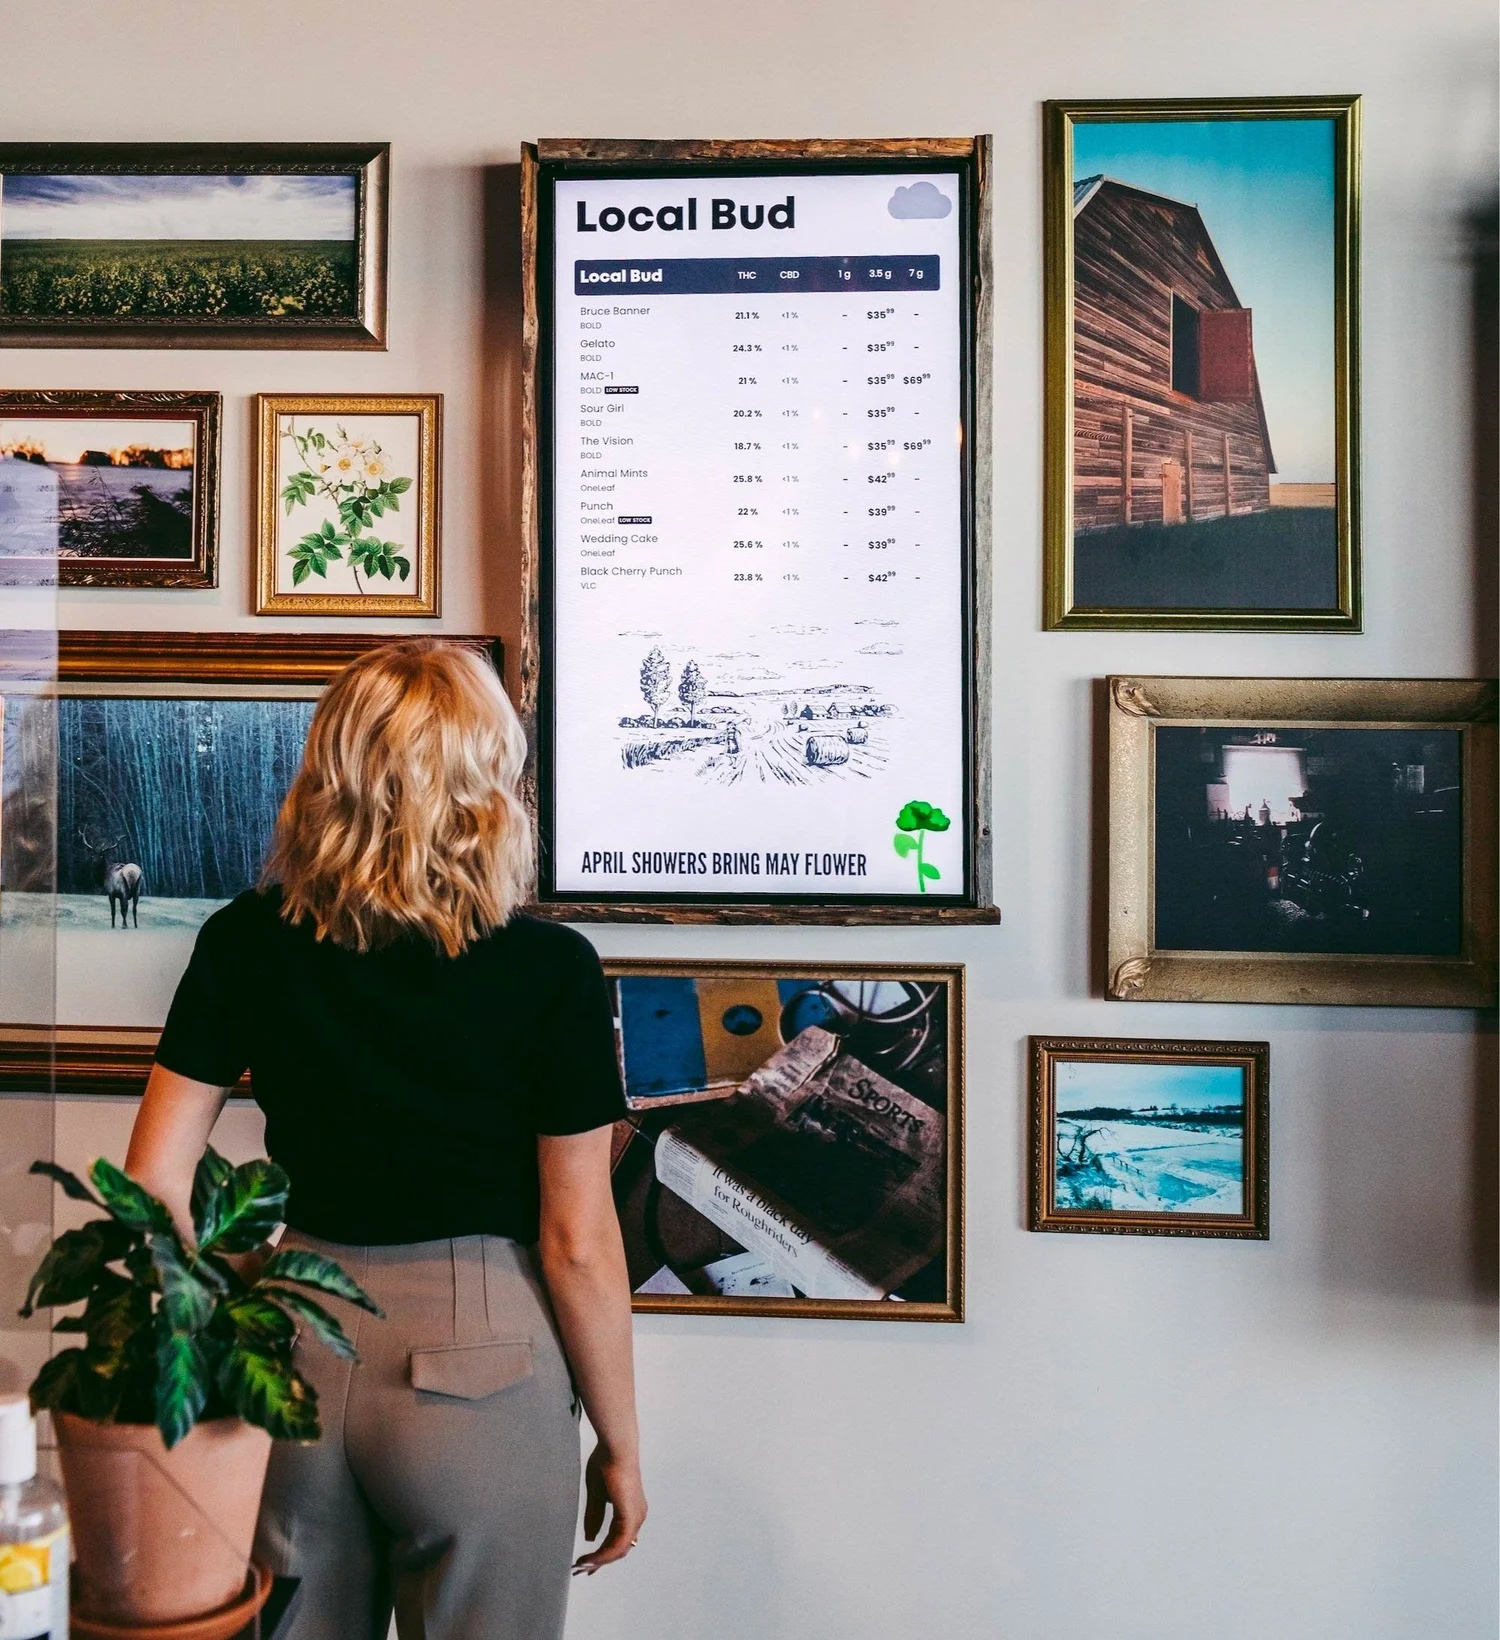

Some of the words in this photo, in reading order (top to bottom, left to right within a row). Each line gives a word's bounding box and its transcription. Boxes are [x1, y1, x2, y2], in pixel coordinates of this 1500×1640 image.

[576, 198, 698, 233] Local
[711, 196, 796, 231] Bud
[580, 268, 627, 283] Local
[630, 268, 663, 283] Bud
[737, 271, 757, 280] THC
[779, 270, 800, 280] CBD
[580, 306, 611, 316] Bruce
[612, 306, 651, 316] Banner
[579, 321, 603, 330] BOLD
[579, 338, 616, 349] Gelato
[579, 354, 603, 362] BOLD
[580, 371, 614, 381] MAC-1
[580, 386, 603, 395] BOLD
[580, 404, 605, 414] Sour
[606, 403, 625, 414] Girl
[580, 419, 603, 427] BOLD
[580, 436, 600, 446] The
[601, 436, 634, 446] Vision
[580, 451, 603, 460] BOLD
[580, 468, 618, 478] Animal
[620, 468, 649, 478] Mints
[579, 483, 616, 492] OneLeaf
[580, 501, 614, 511] Punch
[579, 516, 616, 525] OneLeaf
[580, 533, 629, 546] Wedding
[630, 533, 659, 544] Cake
[580, 548, 616, 558] OneLeaf
[580, 566, 609, 576] Black
[611, 566, 647, 579] Cherry
[649, 566, 683, 576] Punch
[580, 581, 597, 590] VLC
[581, 850, 628, 874] APRIL
[631, 851, 708, 875] SHOWERS
[712, 852, 760, 876] BRING
[765, 852, 800, 876] MAY
[804, 852, 867, 877] FLOWER
[848, 1078, 925, 1133] SPORTS
[712, 1166, 723, 1179] It
[724, 1174, 747, 1195] was
[746, 1192, 756, 1203] a
[756, 1198, 790, 1227] black
[790, 1220, 813, 1245] day
[714, 1185, 730, 1203] for
[732, 1198, 798, 1258] Roughriders
